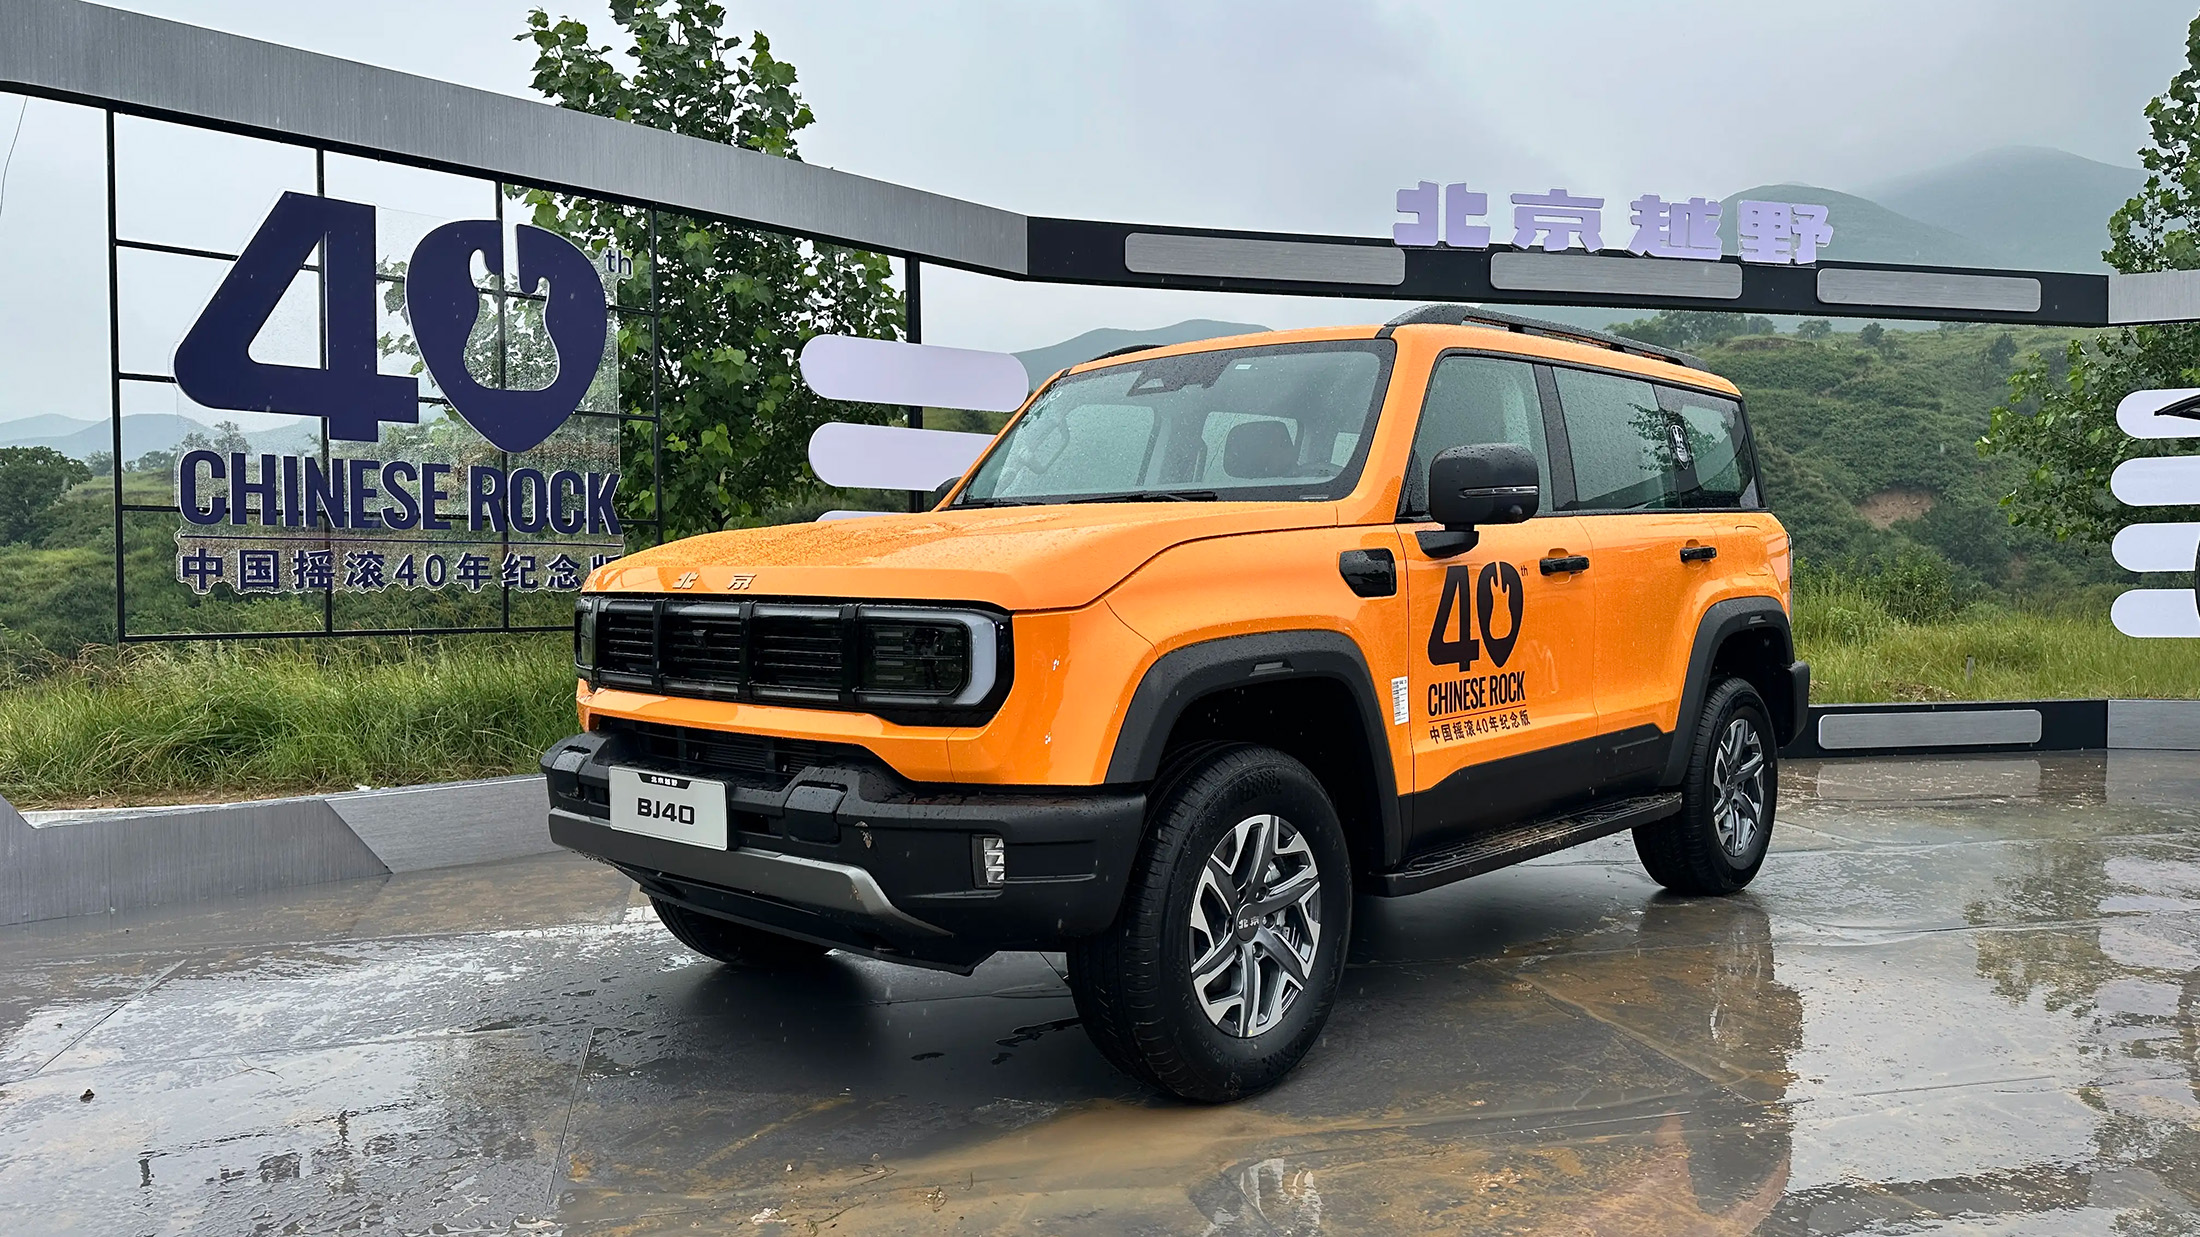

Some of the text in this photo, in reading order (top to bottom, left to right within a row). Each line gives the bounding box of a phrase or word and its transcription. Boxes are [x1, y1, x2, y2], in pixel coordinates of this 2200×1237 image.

[1393, 181, 1834, 265] 北京越野
[179, 449, 623, 535] CHINESE ROCK
[181, 547, 621, 591] 中国摇滚40年纪念
[1428, 677, 1487, 717] CHINESE
[1489, 670, 1526, 707] ROCK
[1429, 709, 1531, 744] 中国摇滚40年纪念版
[637, 797, 695, 825] BJ40
